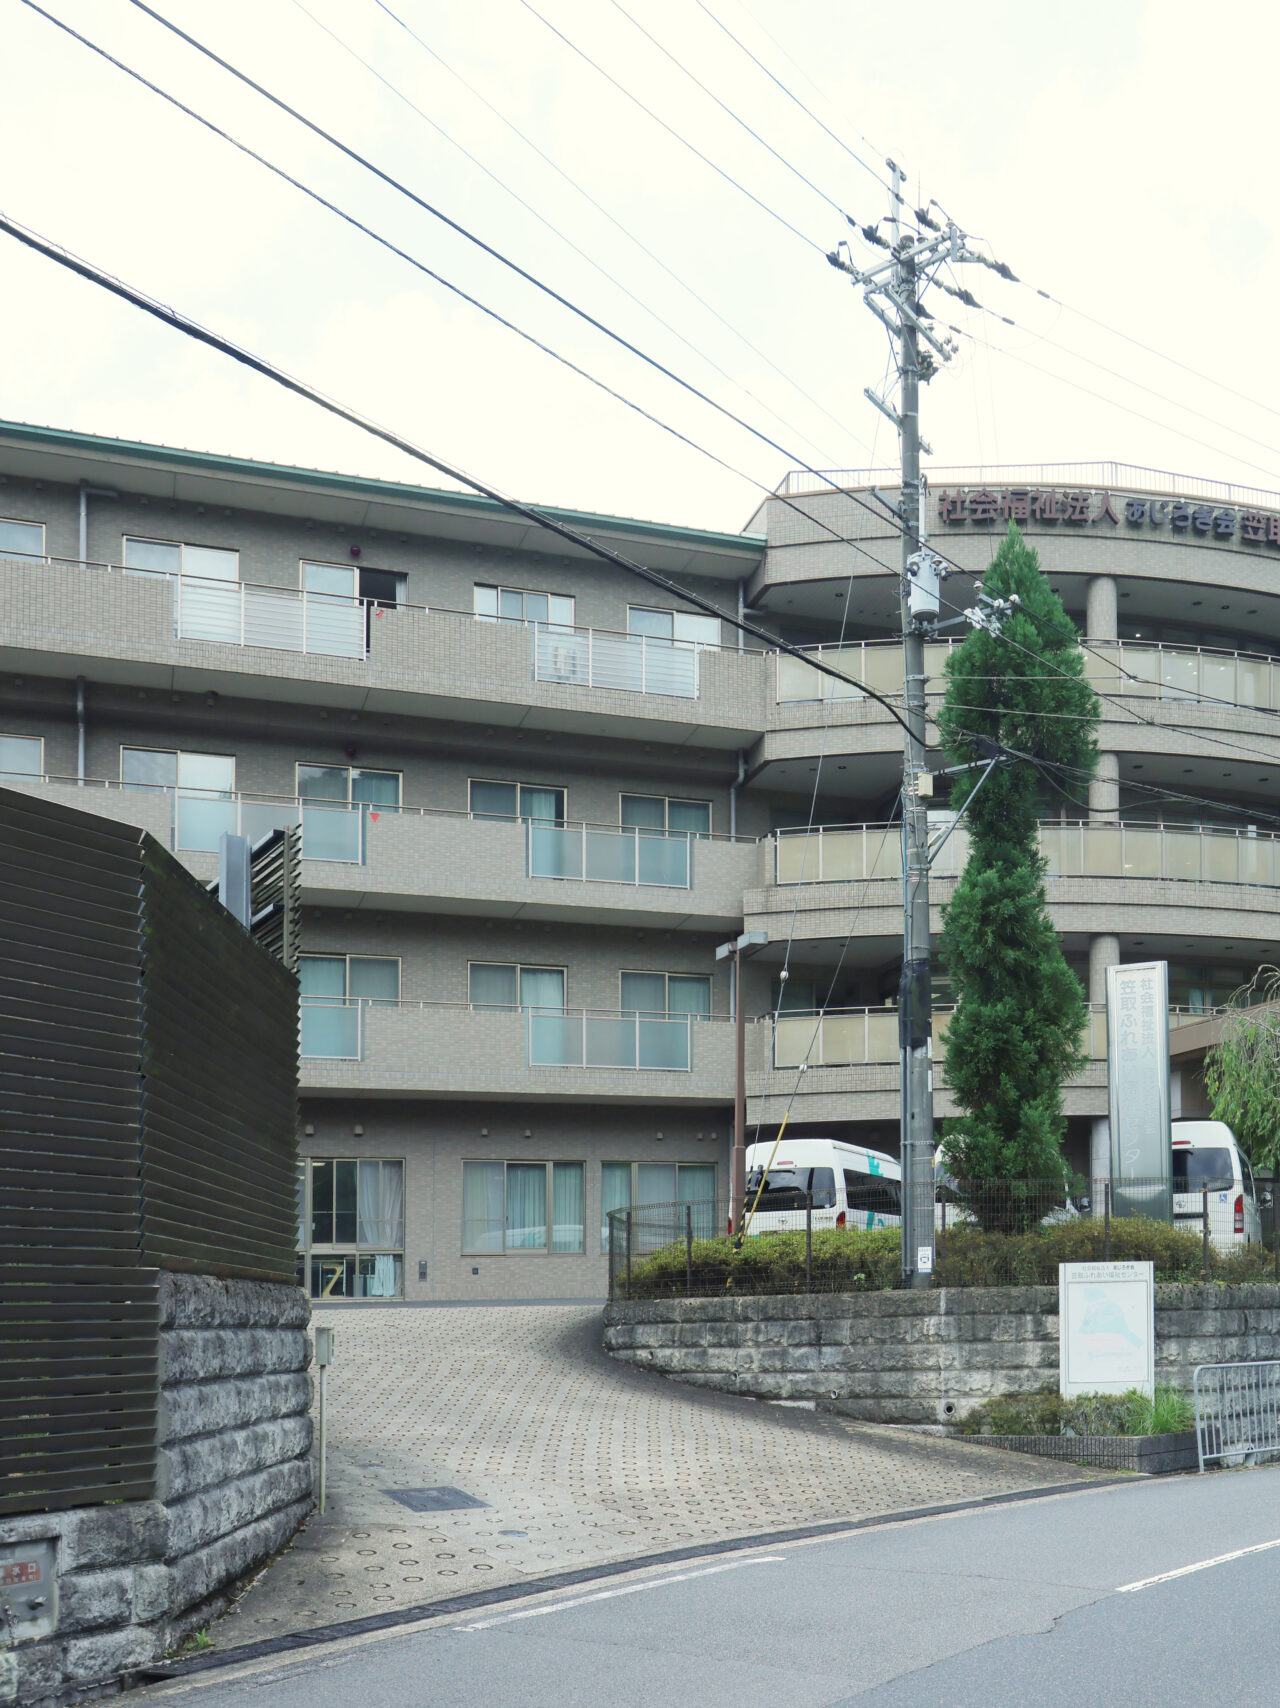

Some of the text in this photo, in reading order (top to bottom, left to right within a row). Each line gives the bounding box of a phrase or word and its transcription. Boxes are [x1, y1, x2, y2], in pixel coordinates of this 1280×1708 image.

[938, 487, 1120, 525] 社会福祉法人
[1125, 497, 1237, 537] あじろぎ会
[1140, 977, 1155, 1058] 社会福祉法人
